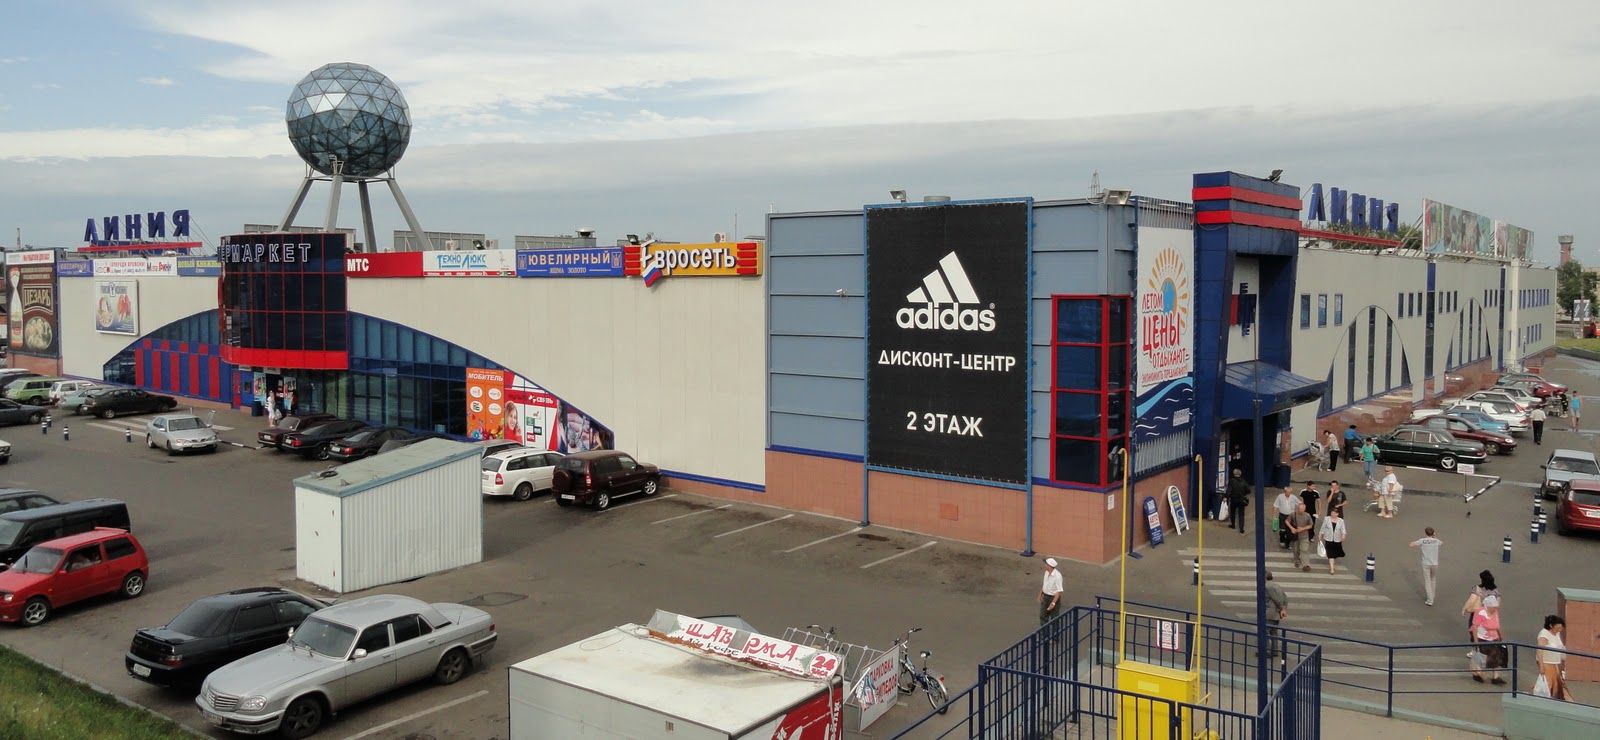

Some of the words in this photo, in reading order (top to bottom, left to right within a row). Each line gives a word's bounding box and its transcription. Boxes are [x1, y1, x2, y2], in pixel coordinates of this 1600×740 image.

[84, 209, 190, 242] ЛИНИЯ
[217, 243, 311, 262] ЕРМАРКЕТ
[528, 250, 610, 266] ЮВЕЛИРНЫЙ
[640, 239, 736, 276] Евросеть
[347, 258, 370, 273] МТС
[24, 289, 51, 307] ЦЕЗАРЬ
[1142, 293, 1163, 310] ЛЕТОМ
[896, 302, 996, 332] adidas
[1143, 311, 1181, 360] ЦЕНЫ
[878, 349, 1016, 373] ДИСКОНТ-ЦЕНТР
[468, 373, 504, 382] МОБИТЕЛЬ
[906, 411, 918, 431] 2
[923, 412, 984, 438] ЭТАЖ
[811, 656, 836, 671] 24
